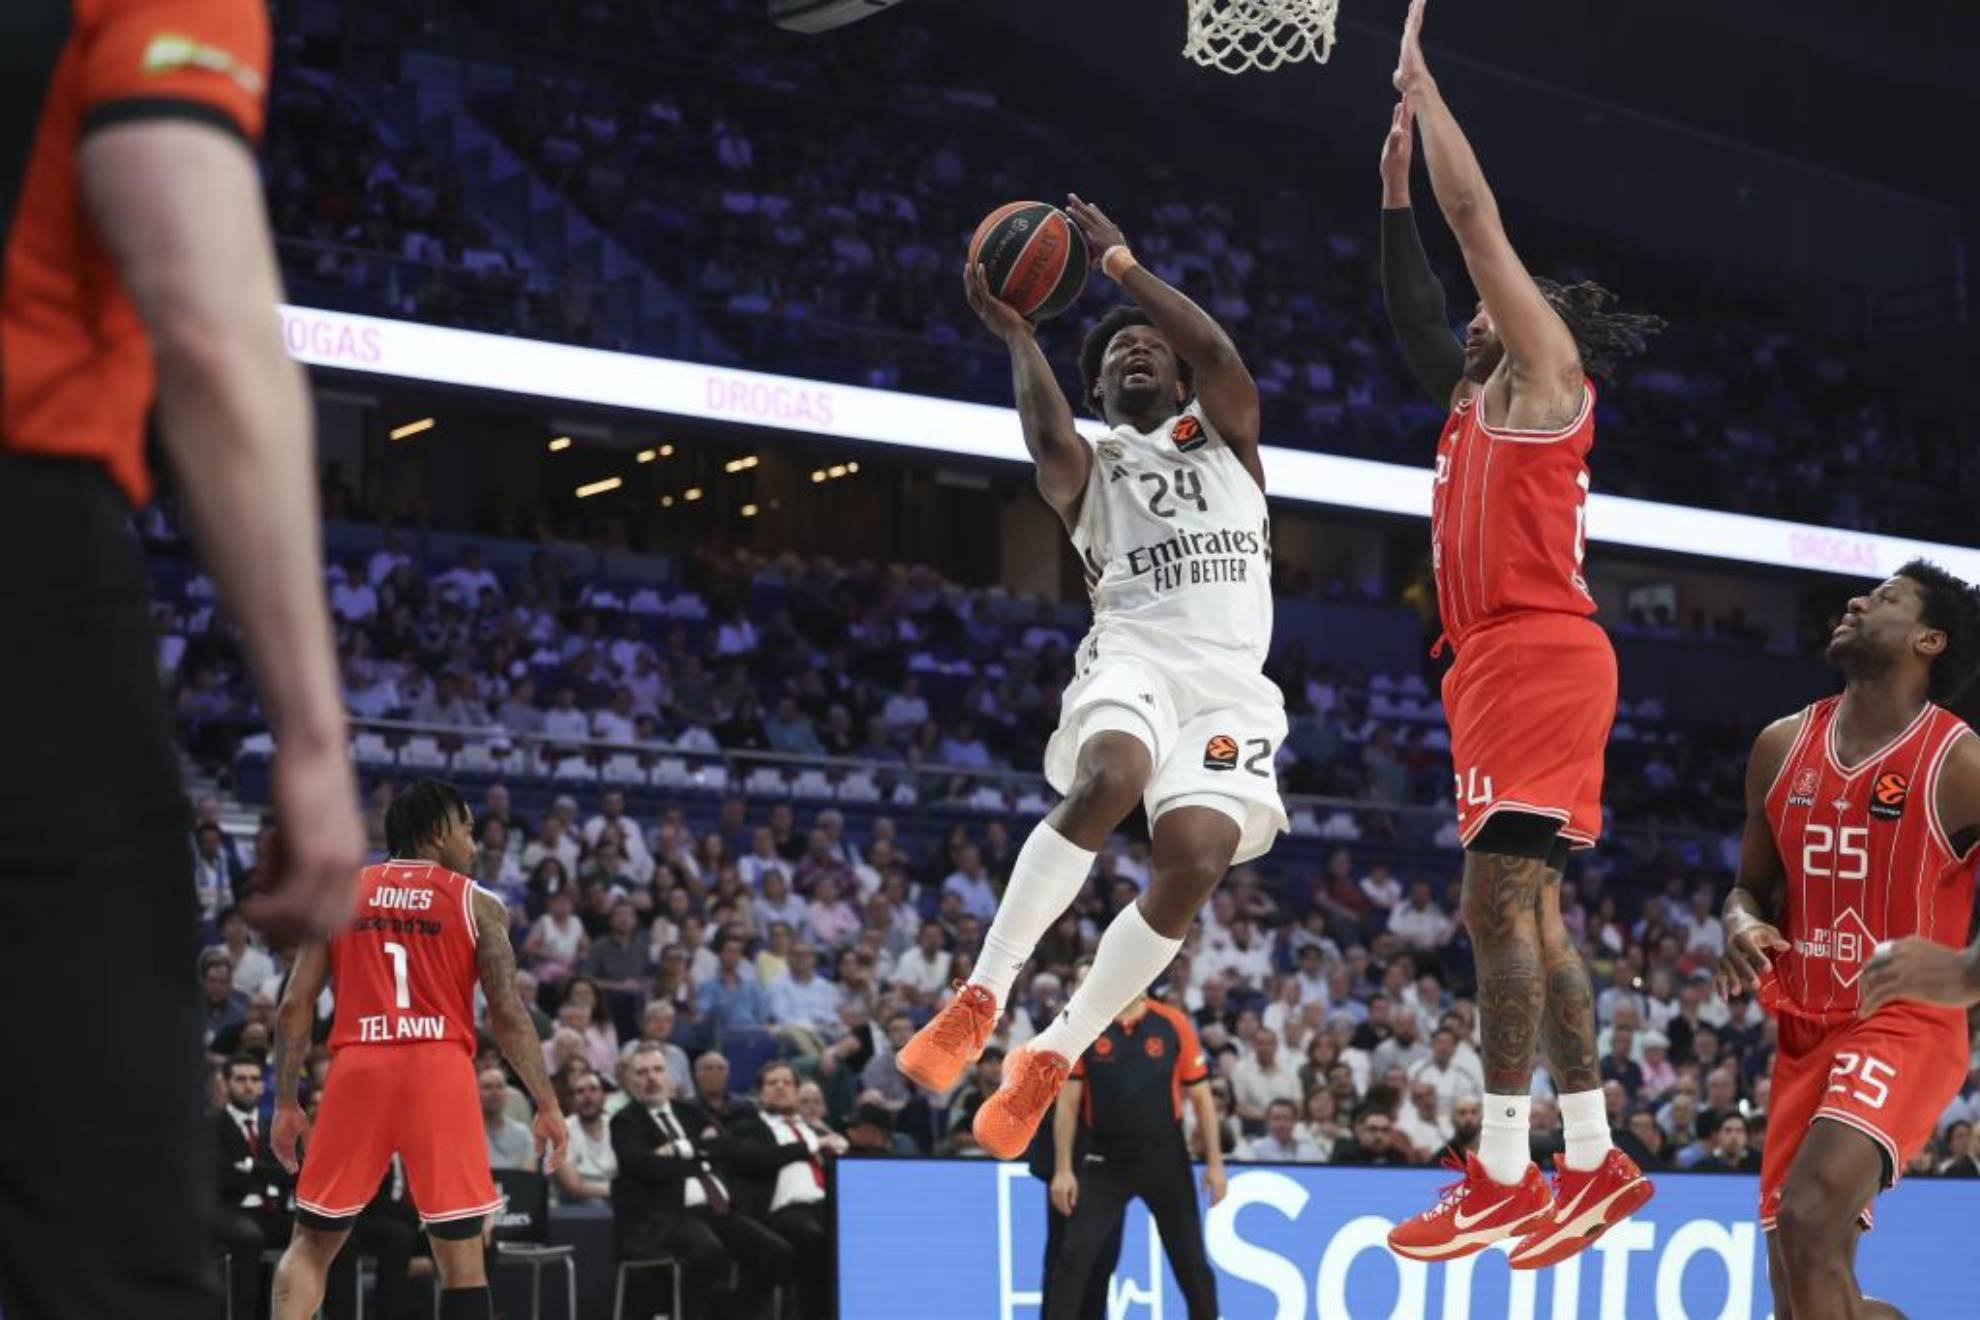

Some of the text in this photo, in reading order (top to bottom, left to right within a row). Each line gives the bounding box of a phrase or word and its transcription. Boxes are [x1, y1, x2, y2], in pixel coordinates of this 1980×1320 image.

[286, 317, 382, 363] OGAS
[705, 376, 834, 426] DROGAS
[1139, 468, 1208, 517] 24
[1127, 528, 1259, 576] Emirates
[1154, 558, 1247, 592] FLY BETTER
[1803, 824, 1868, 880] 25
[368, 886, 433, 910] JONES
[384, 942, 410, 1008] 1
[359, 1014, 445, 1042] TEL AVIV
[1829, 1053, 1896, 1109] 25
[1206, 1171, 1772, 1320] Sanita
